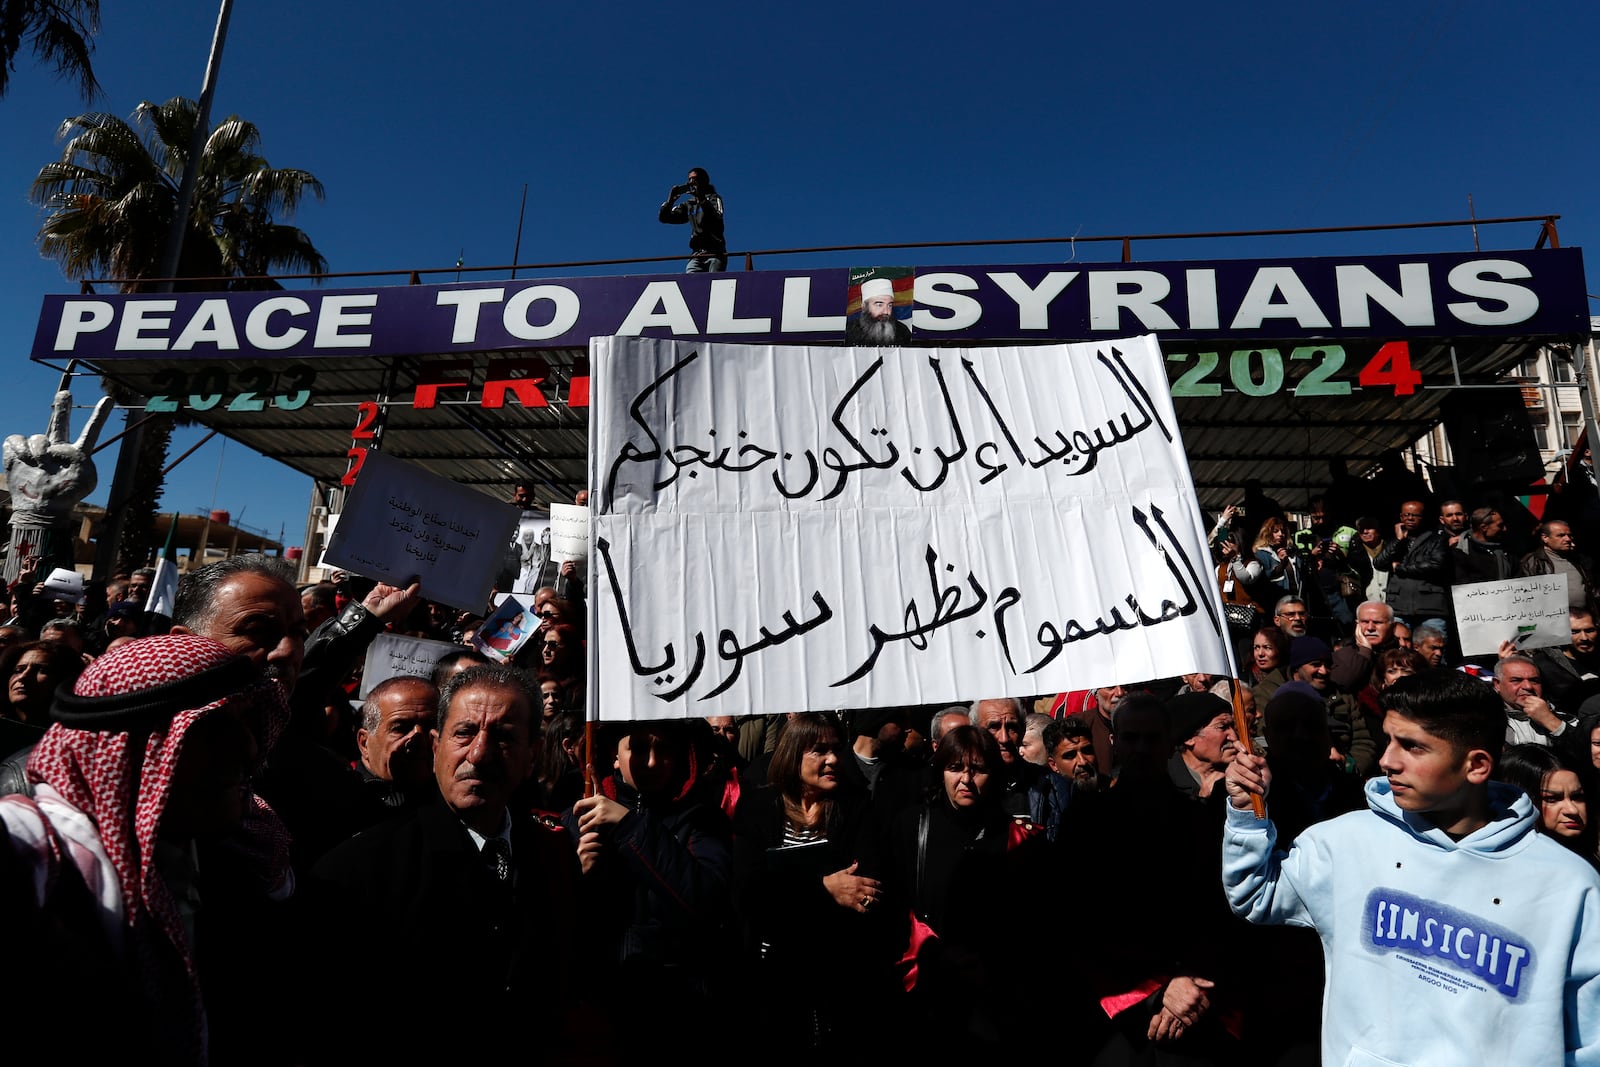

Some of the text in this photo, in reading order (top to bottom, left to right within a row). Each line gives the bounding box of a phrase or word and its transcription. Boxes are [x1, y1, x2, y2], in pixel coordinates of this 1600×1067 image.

[53, 259, 1540, 352] PEACE TO ALL SYRIANS
[143, 365, 316, 413] 2023
[1167, 341, 1422, 397] 2024
[608, 347, 1173, 512] السويداء لن تكون خنجركم
[388, 496, 423, 518] الوطنية
[405, 542, 437, 567] بتاريخنا
[414, 530, 430, 542] ولن
[432, 534, 466, 553] السورية
[597, 502, 1222, 702] المسموم بظهر سوريا
[1376, 900, 1527, 988] EINSICHT
